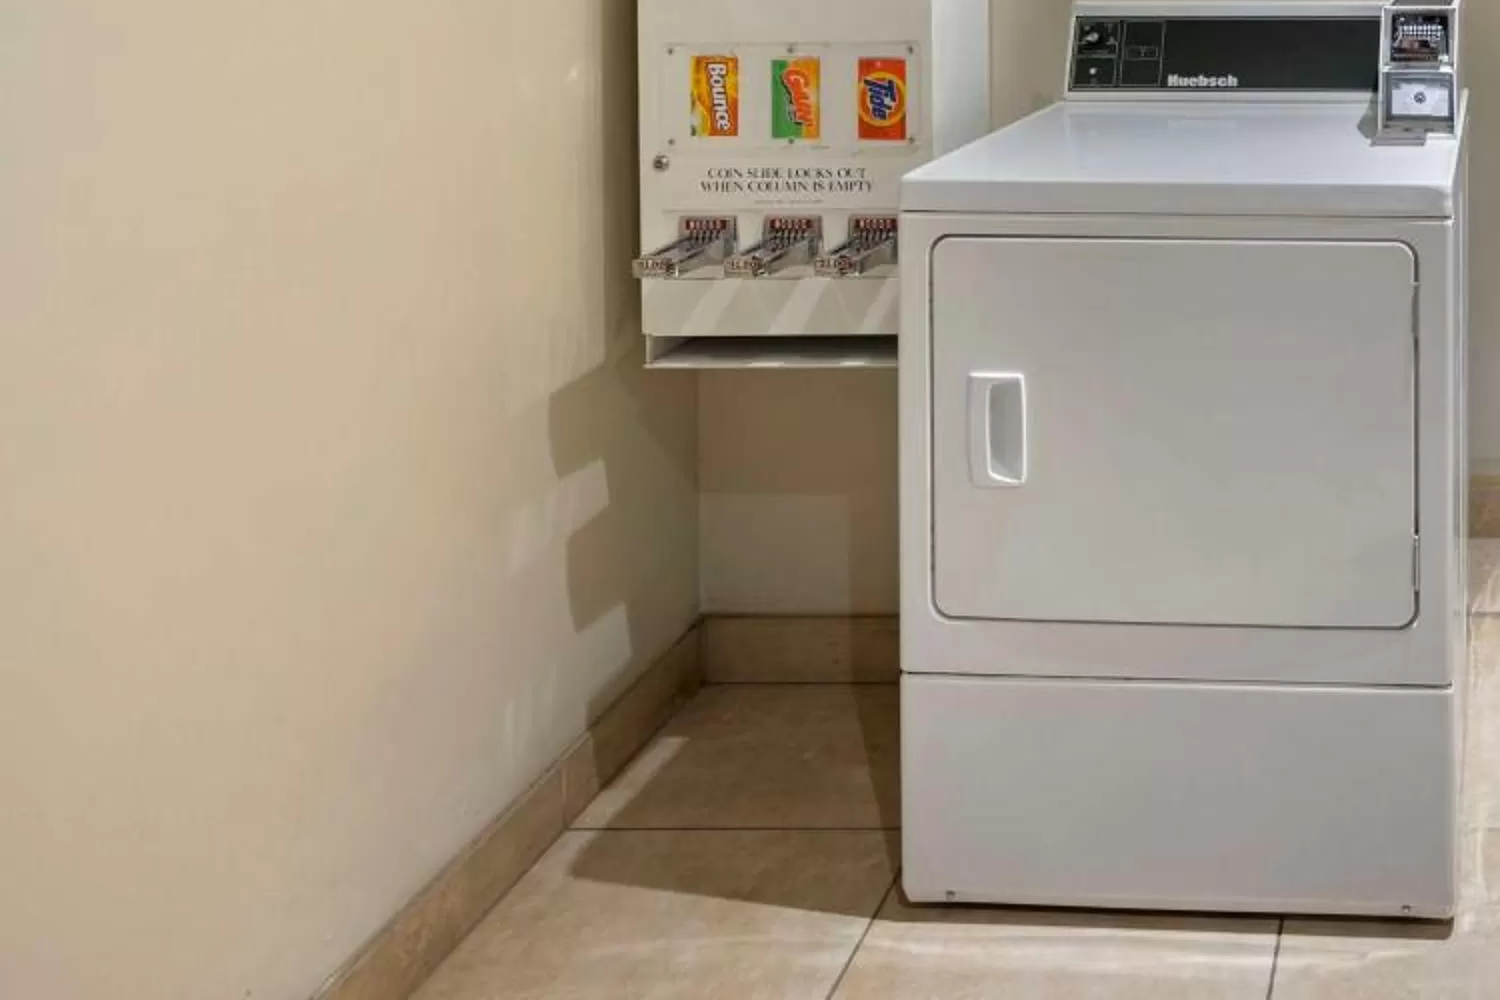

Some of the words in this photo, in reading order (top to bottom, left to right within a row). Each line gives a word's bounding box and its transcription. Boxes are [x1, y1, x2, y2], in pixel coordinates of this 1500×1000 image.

[1167, 73, 1239, 88] Huebsch
[707, 63, 731, 130] Bounce
[863, 79, 897, 120] Tide
[707, 167, 743, 178] COIN
[747, 167, 782, 178] SLIDE
[787, 167, 833, 178] LOCKS
[837, 167, 867, 178] OUT
[700, 180, 744, 192] WHEN
[747, 180, 808, 192] COLUMN
[813, 180, 825, 192] IS
[829, 180, 873, 192] EMPTY
